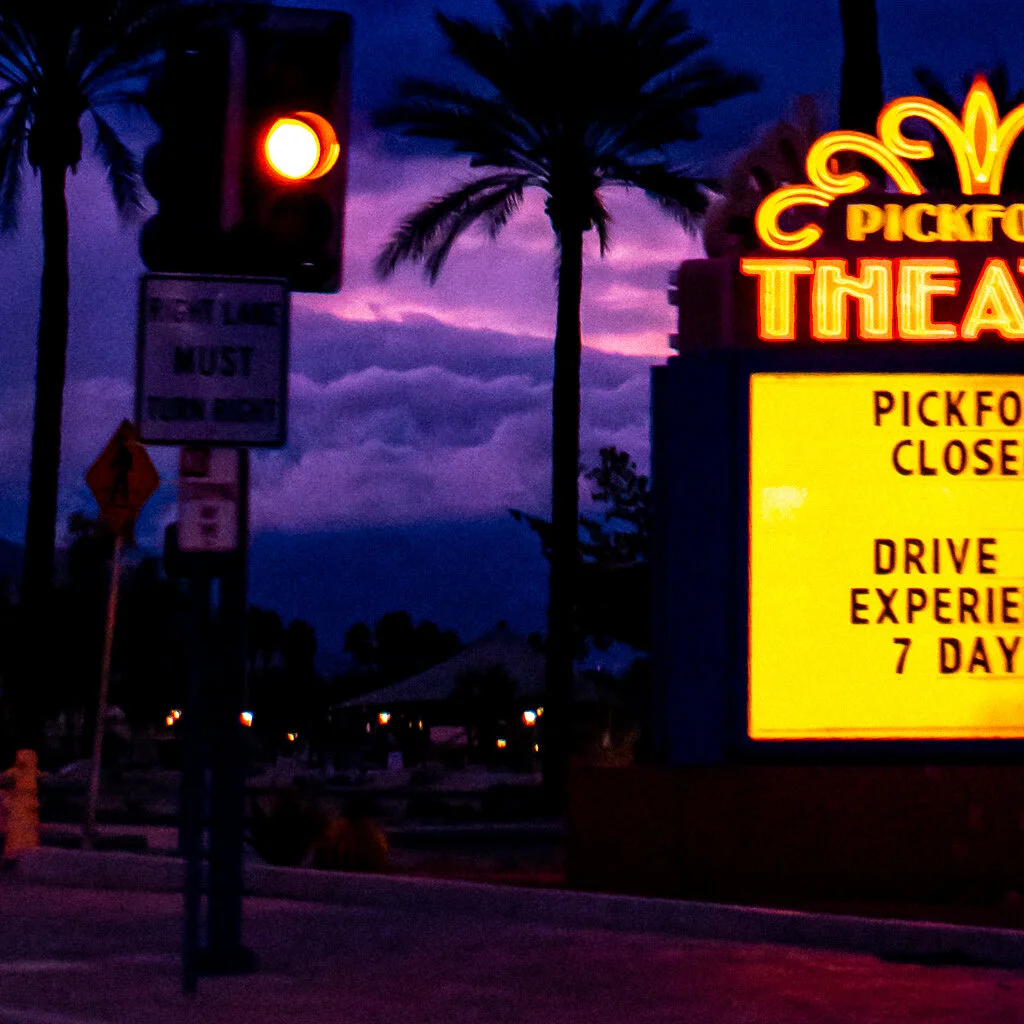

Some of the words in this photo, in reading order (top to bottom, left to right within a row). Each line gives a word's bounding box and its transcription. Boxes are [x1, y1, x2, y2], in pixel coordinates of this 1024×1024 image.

[175, 346, 254, 377] MUST
[873, 538, 997, 575] DRIVE
[892, 637, 912, 674] 7
